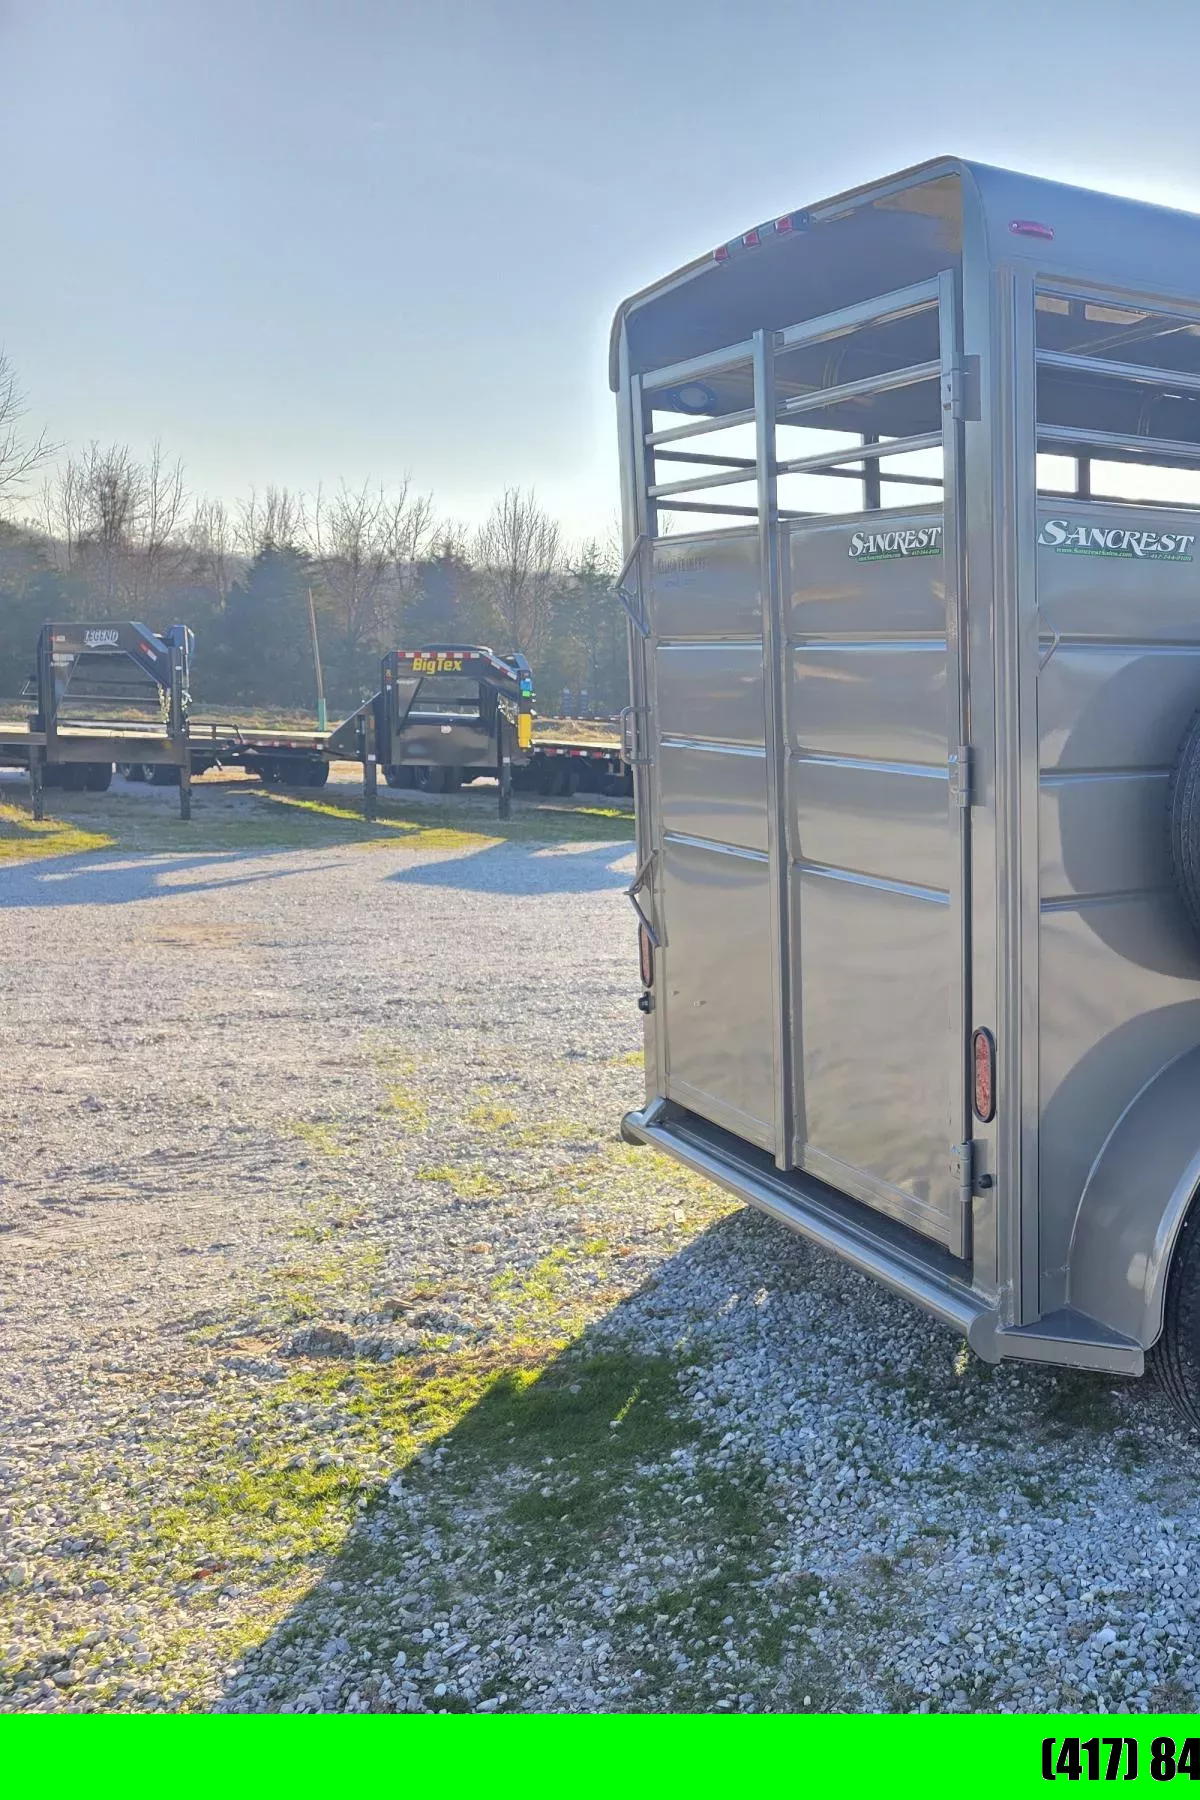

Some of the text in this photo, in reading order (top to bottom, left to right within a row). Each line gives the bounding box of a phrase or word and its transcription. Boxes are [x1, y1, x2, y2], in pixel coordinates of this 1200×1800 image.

[848, 527, 942, 557] SANCREST
[1038, 520, 1194, 555] SANCREST
[84, 629, 119, 643] LEGEND
